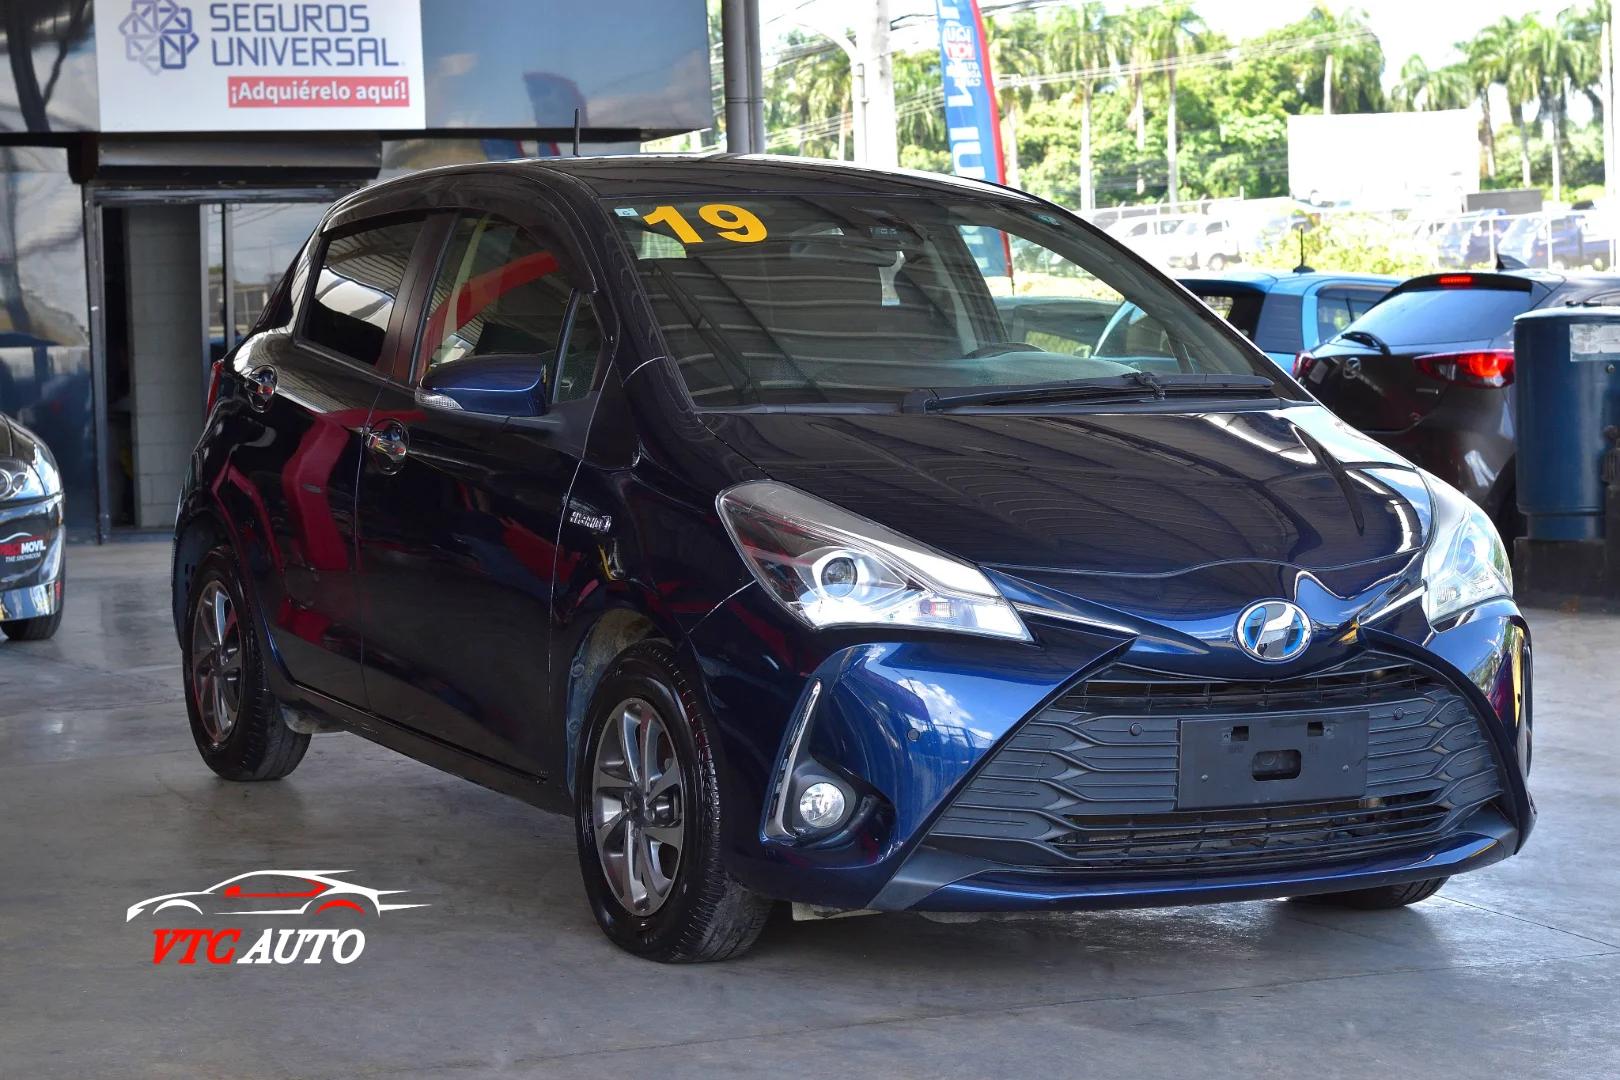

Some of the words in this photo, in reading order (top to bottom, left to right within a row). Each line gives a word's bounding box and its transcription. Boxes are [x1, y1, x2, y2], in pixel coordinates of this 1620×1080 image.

[209, 3, 370, 33] SEGUROS
[211, 37, 400, 67] UNIVERSAL
[230, 80, 351, 105] ¡Adquiérelo
[355, 81, 407, 104] aquí!
[642, 203, 769, 244] 19
